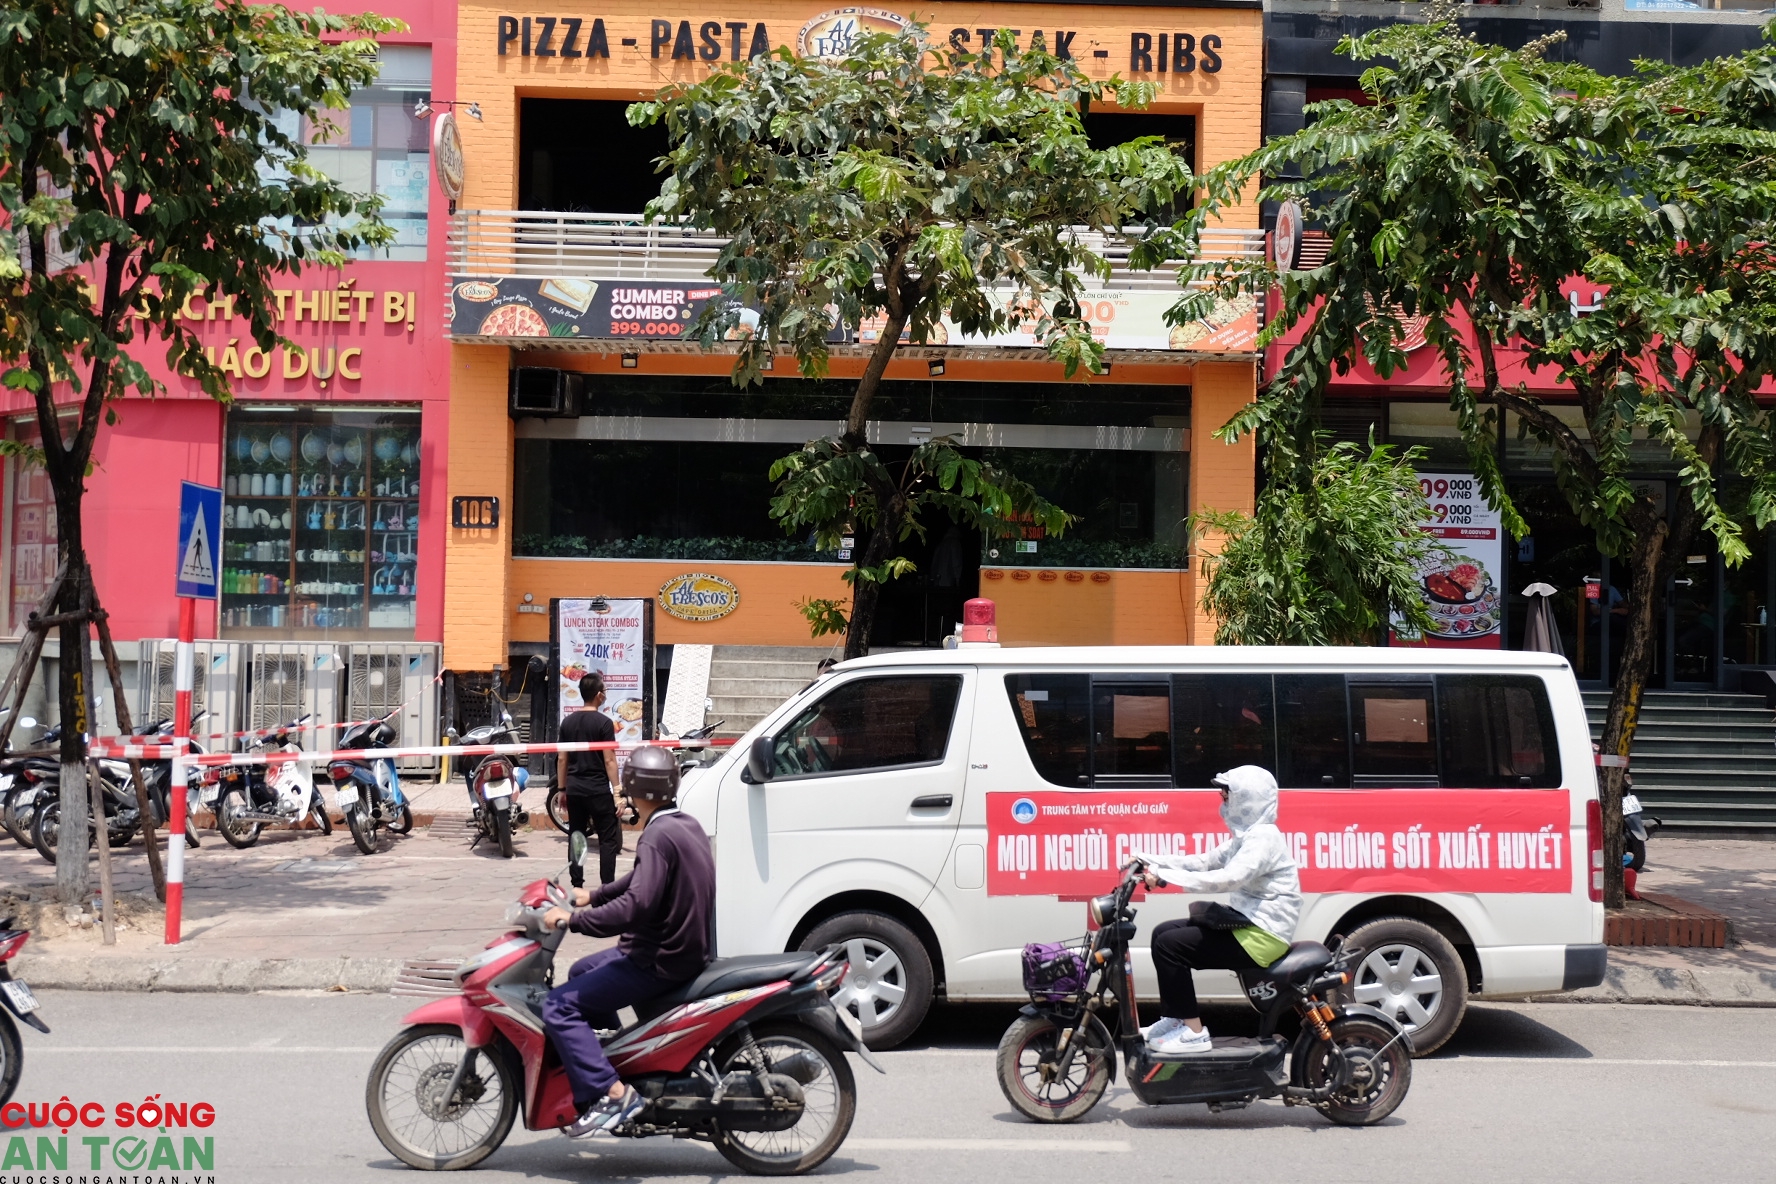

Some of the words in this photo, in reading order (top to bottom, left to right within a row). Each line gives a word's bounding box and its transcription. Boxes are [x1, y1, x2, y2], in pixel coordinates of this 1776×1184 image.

[498, 15, 611, 58] PIZZA
[650, 19, 770, 62] PASTA
[1130, 32, 1222, 74] RIBS
[611, 288, 685, 305] SUMMER
[691, 291, 709, 299] DINE
[710, 290, 718, 298] IN
[134, 288, 233, 321] SCH
[273, 278, 375, 323] THIẾT
[383, 291, 416, 332] BỊ
[610, 305, 677, 321] COMBO
[610, 321, 681, 335] 399.000
[179, 338, 271, 379] IÁO
[283, 347, 362, 389] DỤC
[1450, 479, 1472, 490] 000
[460, 500, 492, 525] 106
[1449, 504, 1472, 515] 000
[677, 580, 694, 596] Al
[563, 617, 586, 628] LUNCH
[588, 617, 609, 628] STEAK
[610, 617, 640, 628] COMBOS
[584, 643, 610, 659] 240K
[1042, 805, 1070, 816] TRUNG
[1071, 803, 1089, 815] TÂM
[1089, 804, 1096, 815] Y
[1096, 802, 1106, 815] TẾ
[1107, 803, 1131, 816] QUẬN
[1149, 802, 1169, 814] GIẤY
[997, 834, 1038, 880] MỌI
[1044, 828, 1109, 872] NGƯỜI
[1314, 823, 1386, 869] CHỐNG
[1392, 823, 1431, 869] SỐT
[1438, 823, 1491, 869] XUẤT
[1499, 823, 1563, 869] HUYẾT
